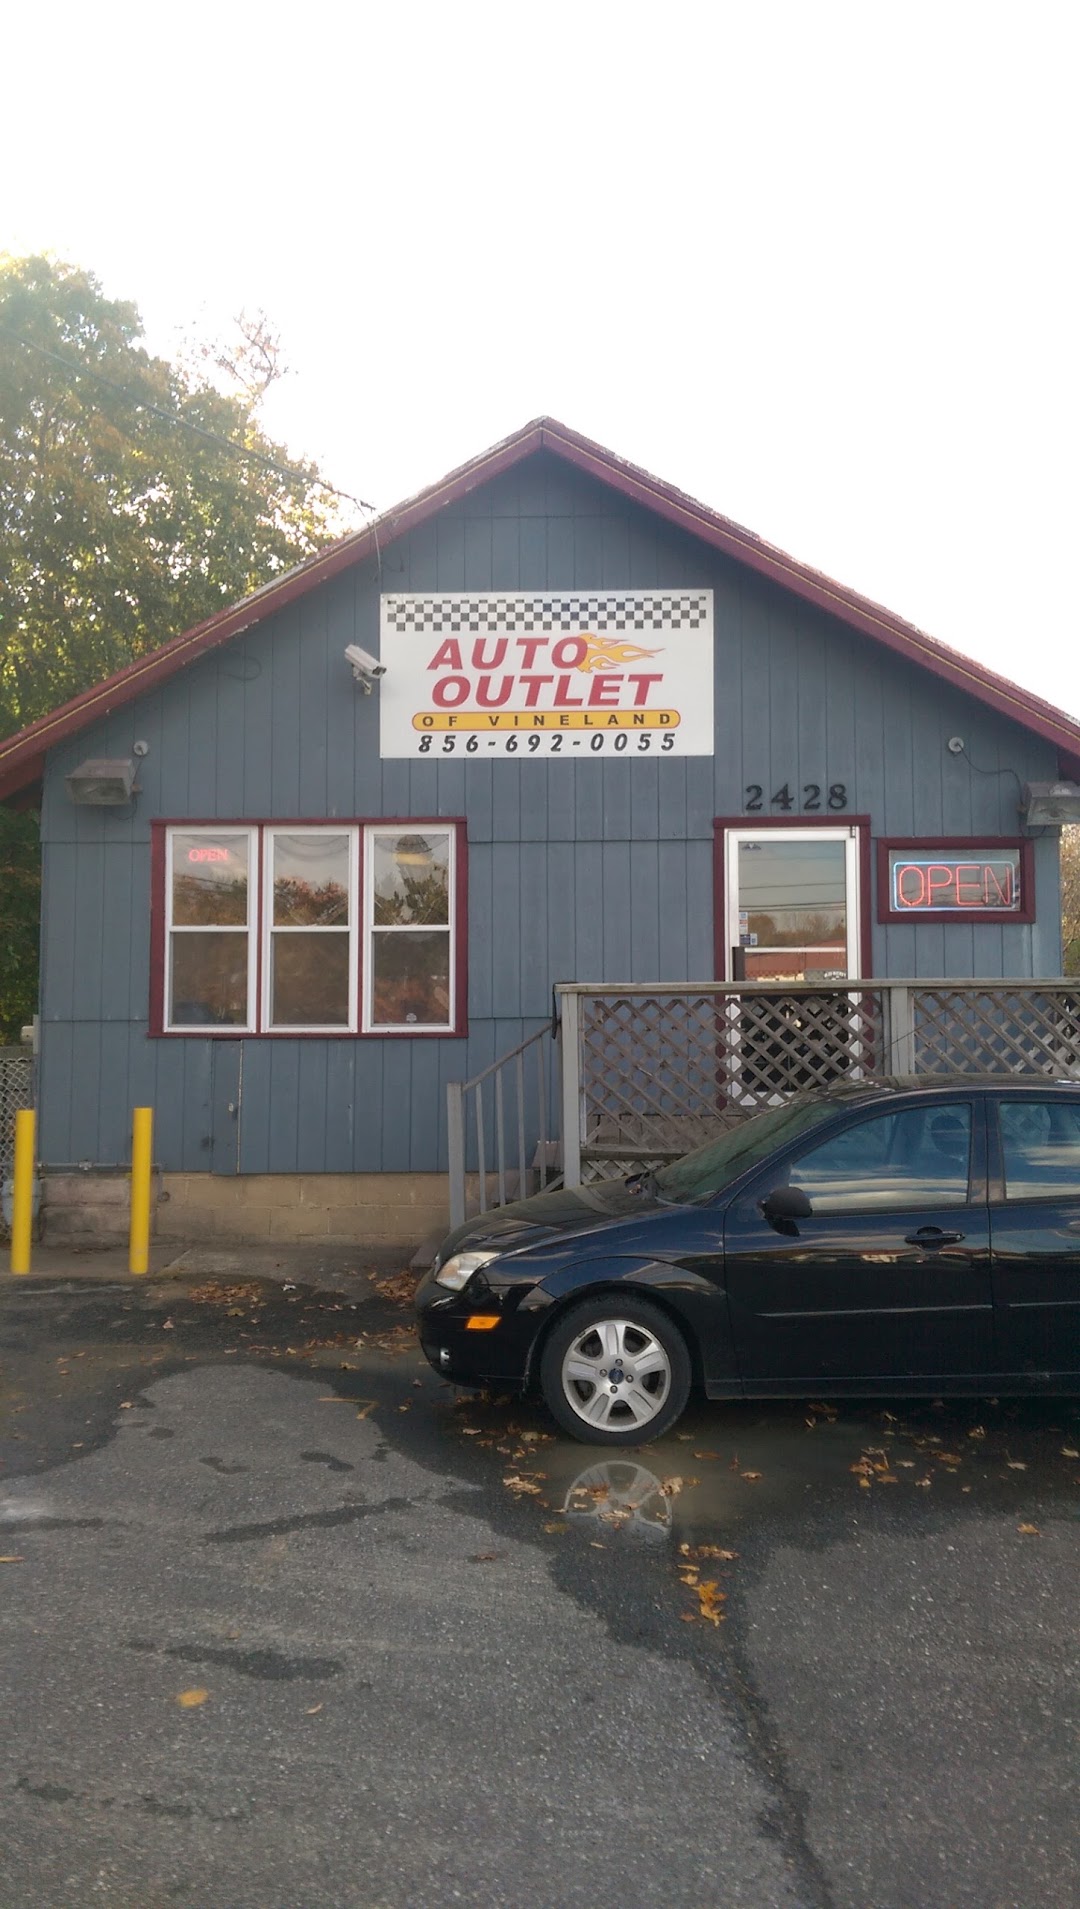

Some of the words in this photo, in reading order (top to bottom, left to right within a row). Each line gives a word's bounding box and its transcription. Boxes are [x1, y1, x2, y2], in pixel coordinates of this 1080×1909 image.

[427, 637, 588, 670] AUTO
[432, 674, 663, 708] OUTLET
[422, 715, 458, 727] OF
[488, 714, 670, 726] VINELAND
[418, 733, 675, 752] 856-692-0055
[745, 784, 848, 810] 2428
[188, 848, 229, 862] OPEN
[898, 865, 1011, 906] OPEN
